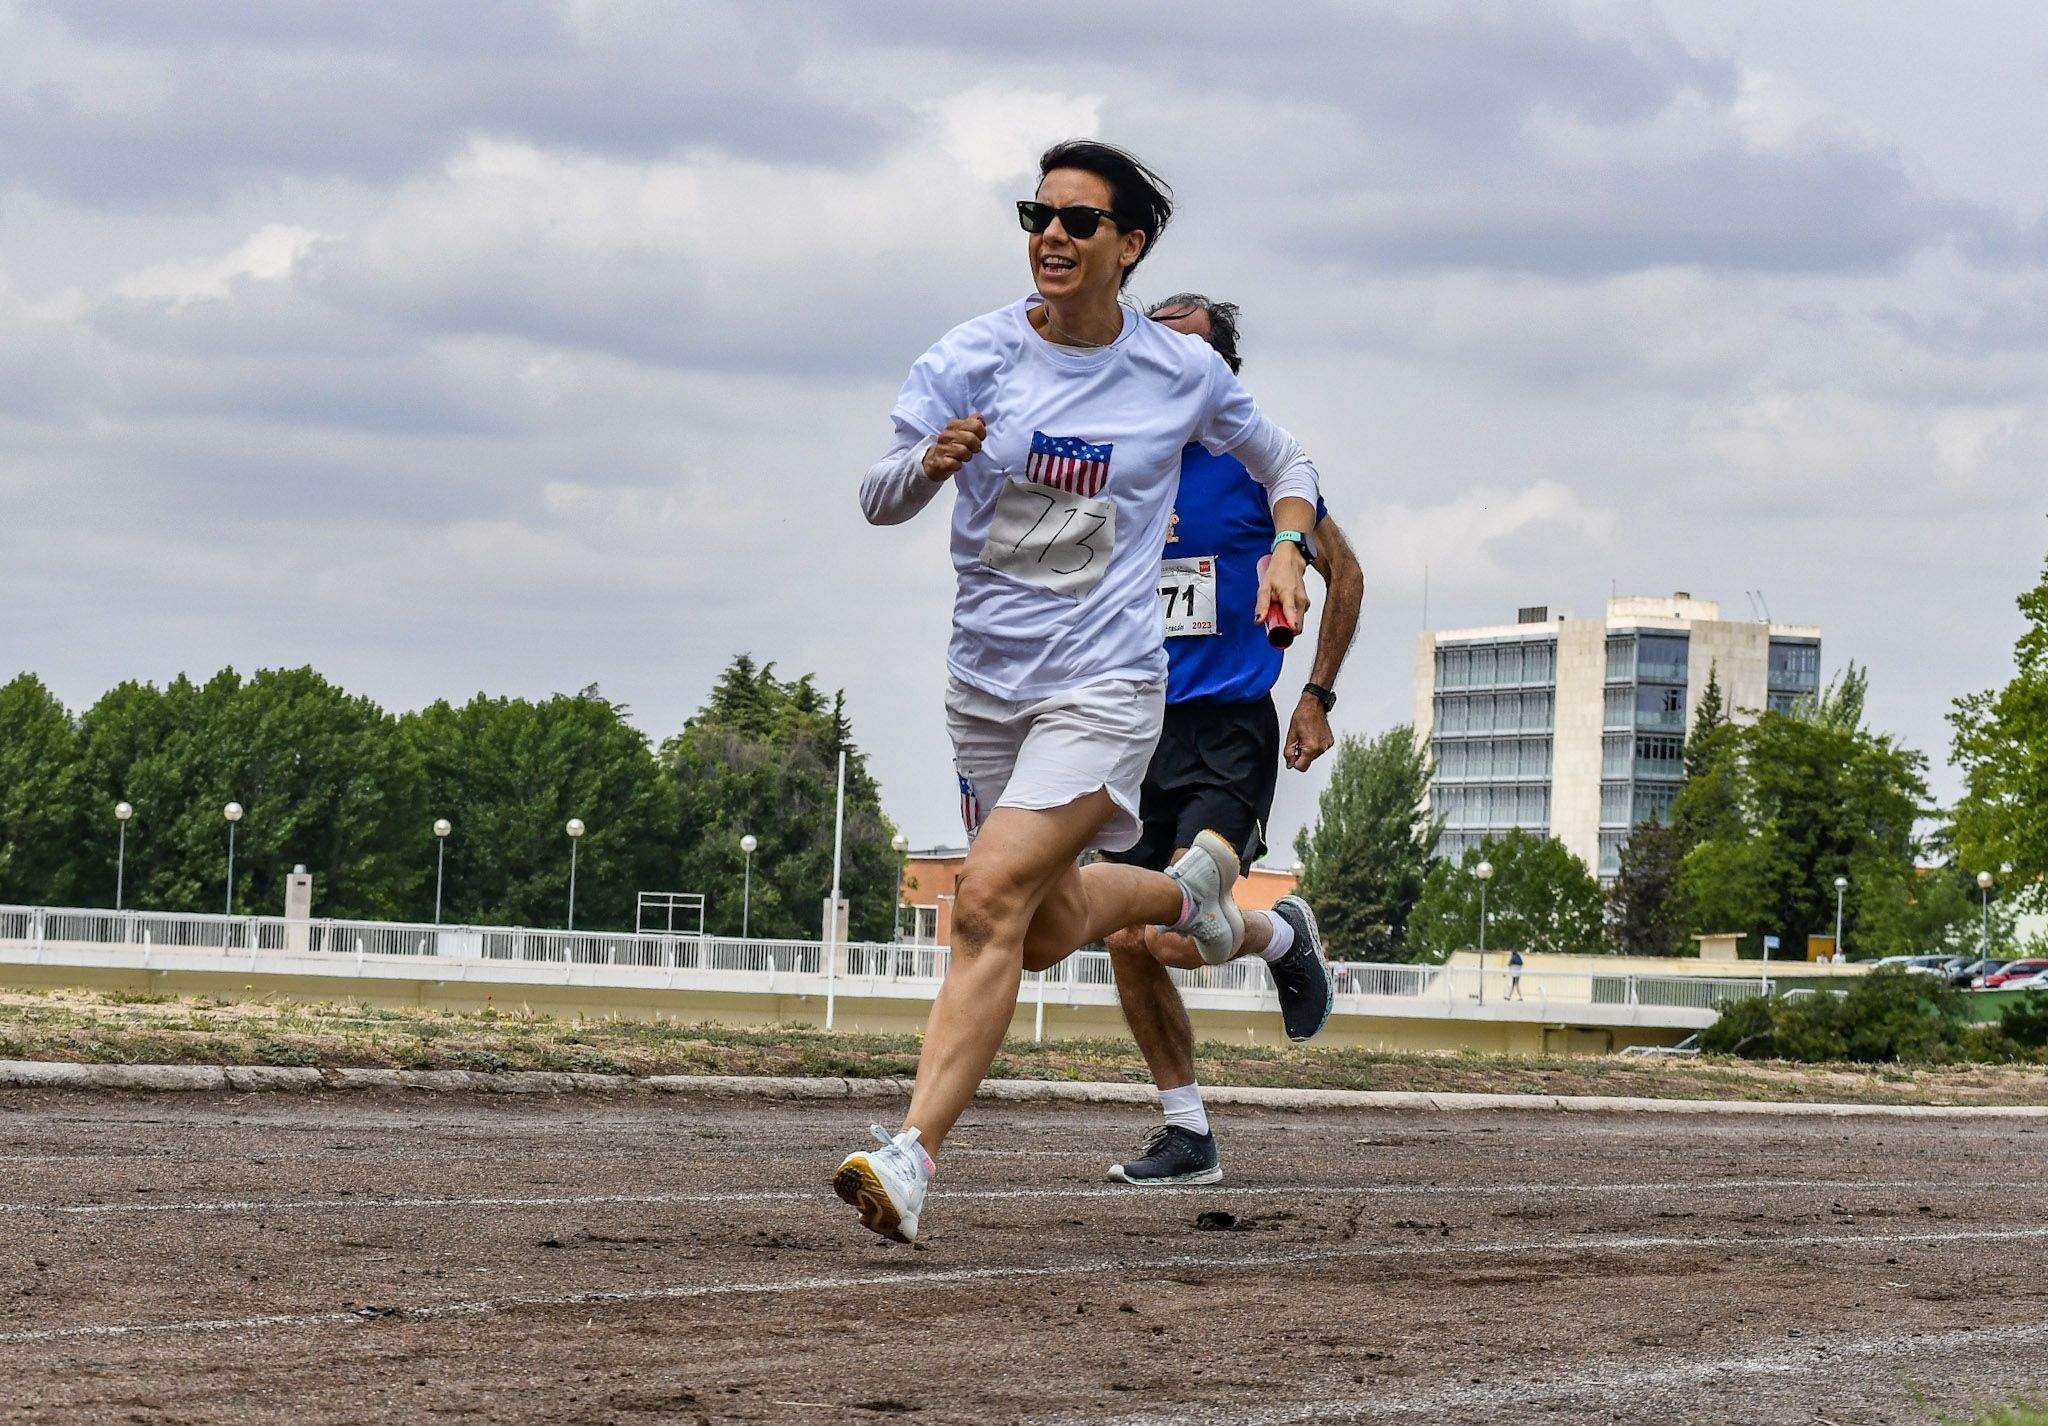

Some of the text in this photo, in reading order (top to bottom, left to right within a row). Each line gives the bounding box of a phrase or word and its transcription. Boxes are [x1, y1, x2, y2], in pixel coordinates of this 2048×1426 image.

[1012, 490, 1107, 575] 713
[1156, 584, 1195, 619] 71
[1192, 621, 1212, 630] 2023
